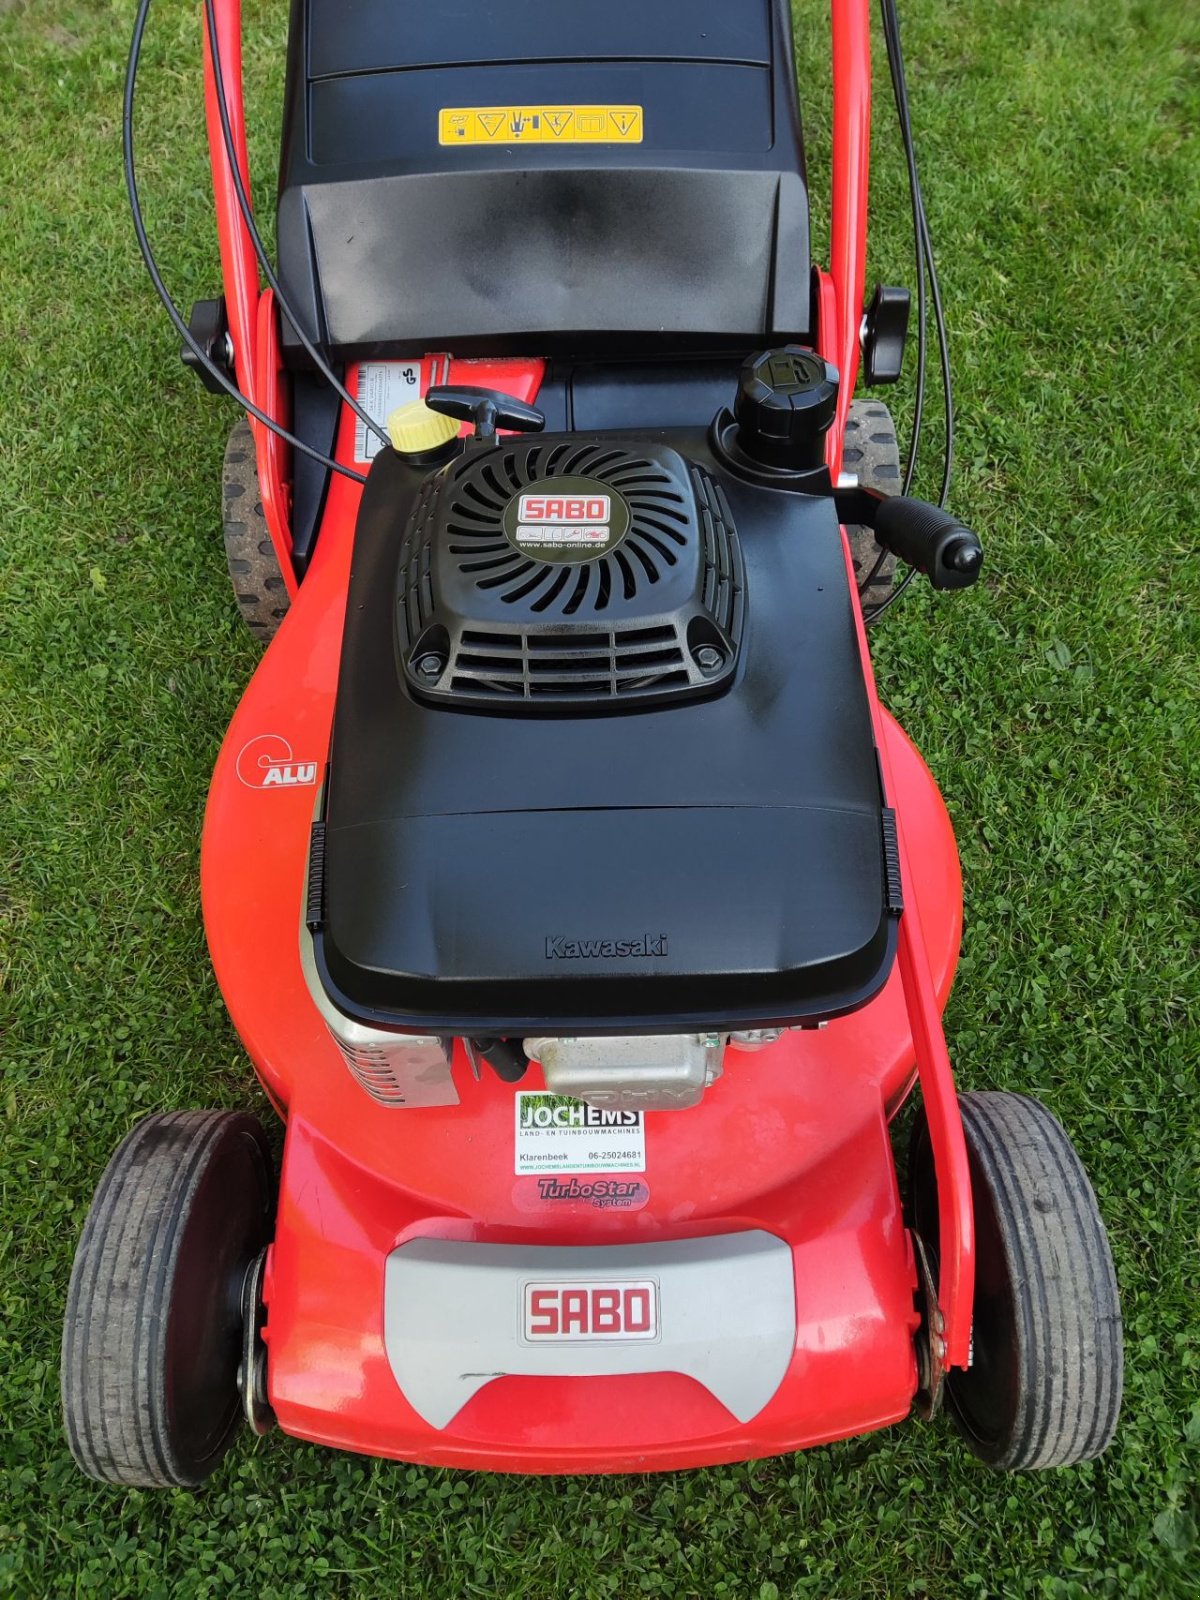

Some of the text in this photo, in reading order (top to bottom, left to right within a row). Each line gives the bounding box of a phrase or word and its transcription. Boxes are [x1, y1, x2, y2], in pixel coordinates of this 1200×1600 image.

[525, 499, 605, 519] SABO
[519, 541, 606, 549] www.sabo-online.de
[262, 765, 315, 785] ALU
[545, 933, 668, 959] Kawasaki
[523, 1106, 637, 1128] JOCHEMS
[559, 1127, 641, 1136] TUINBOUWMACHINES
[519, 1151, 642, 1162] Klarenbeek 06-25024681
[538, 1178, 639, 1199] TurboStar
[592, 1198, 632, 1209] System
[531, 1288, 651, 1334] SABO
